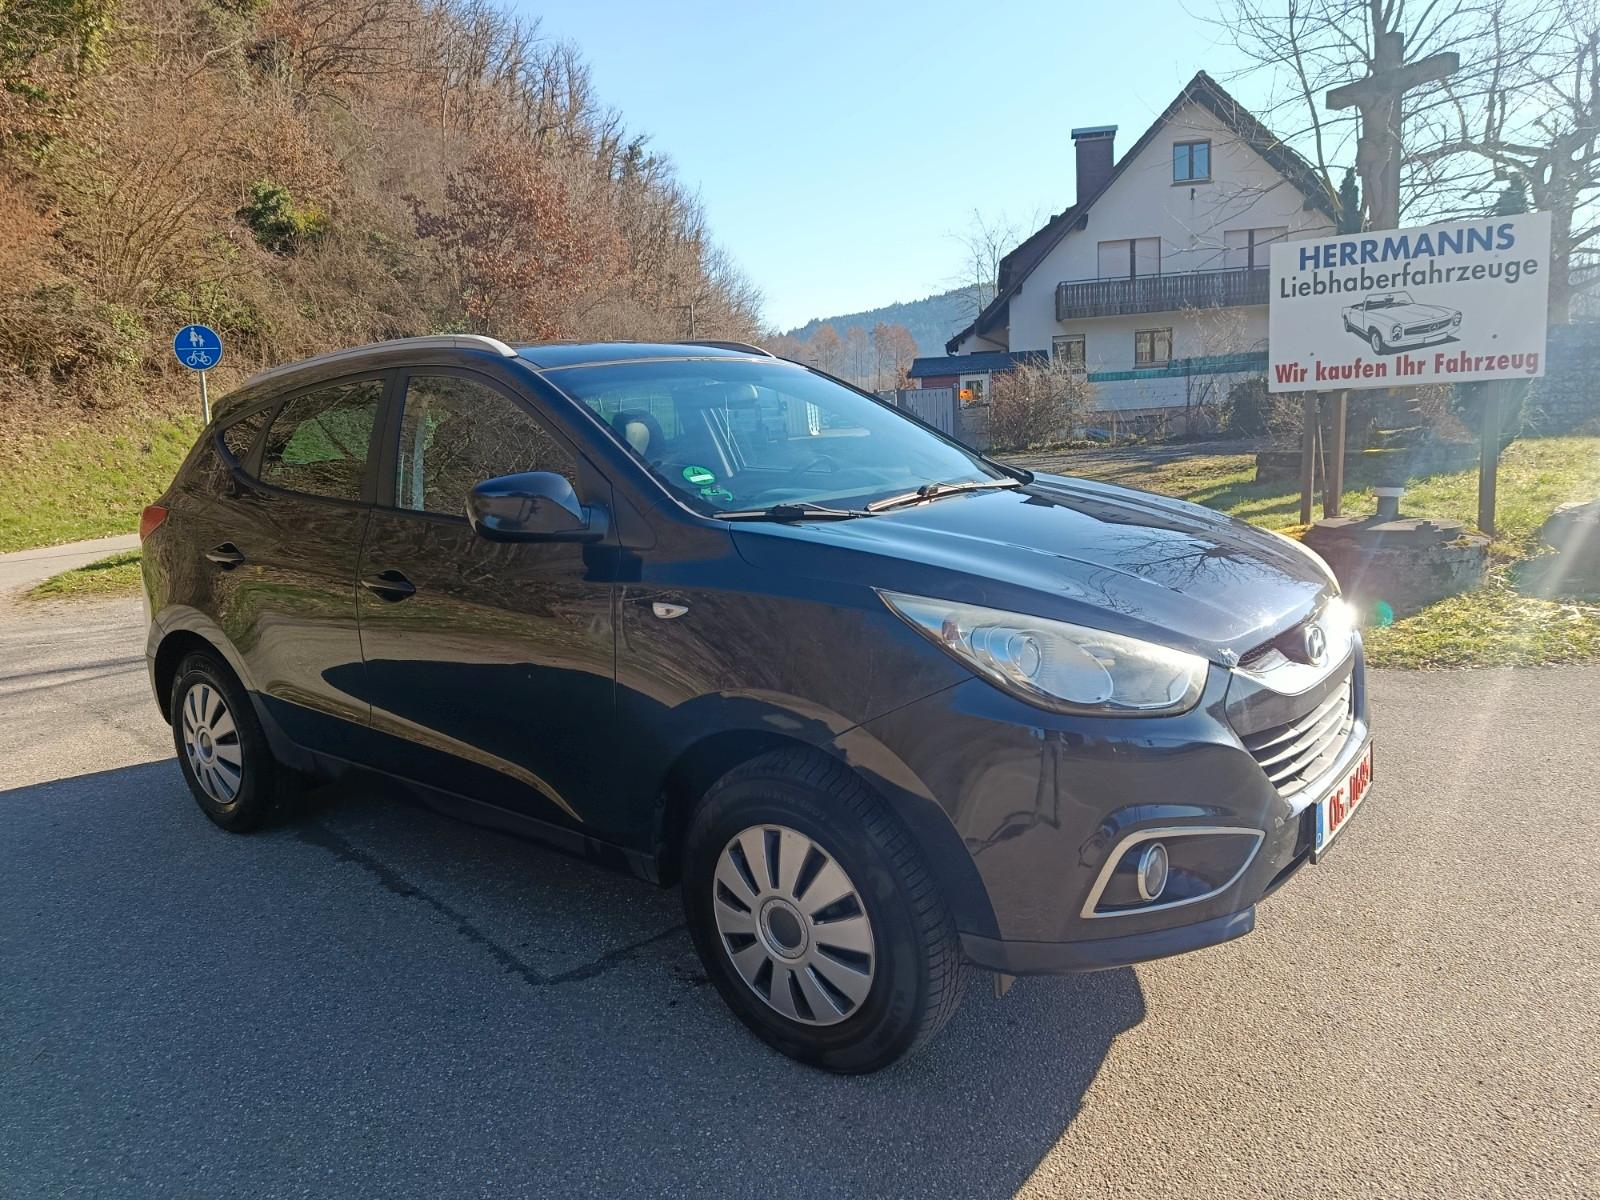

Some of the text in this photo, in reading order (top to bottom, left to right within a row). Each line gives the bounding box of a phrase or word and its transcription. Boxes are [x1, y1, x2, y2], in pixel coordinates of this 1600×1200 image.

[1300, 223, 1515, 271] HERRMANNS
[1280, 258, 1538, 298] Liebhaberfahrzeuge
[1275, 350, 1539, 383] Wir kaufen Ihr Fahrzeug
